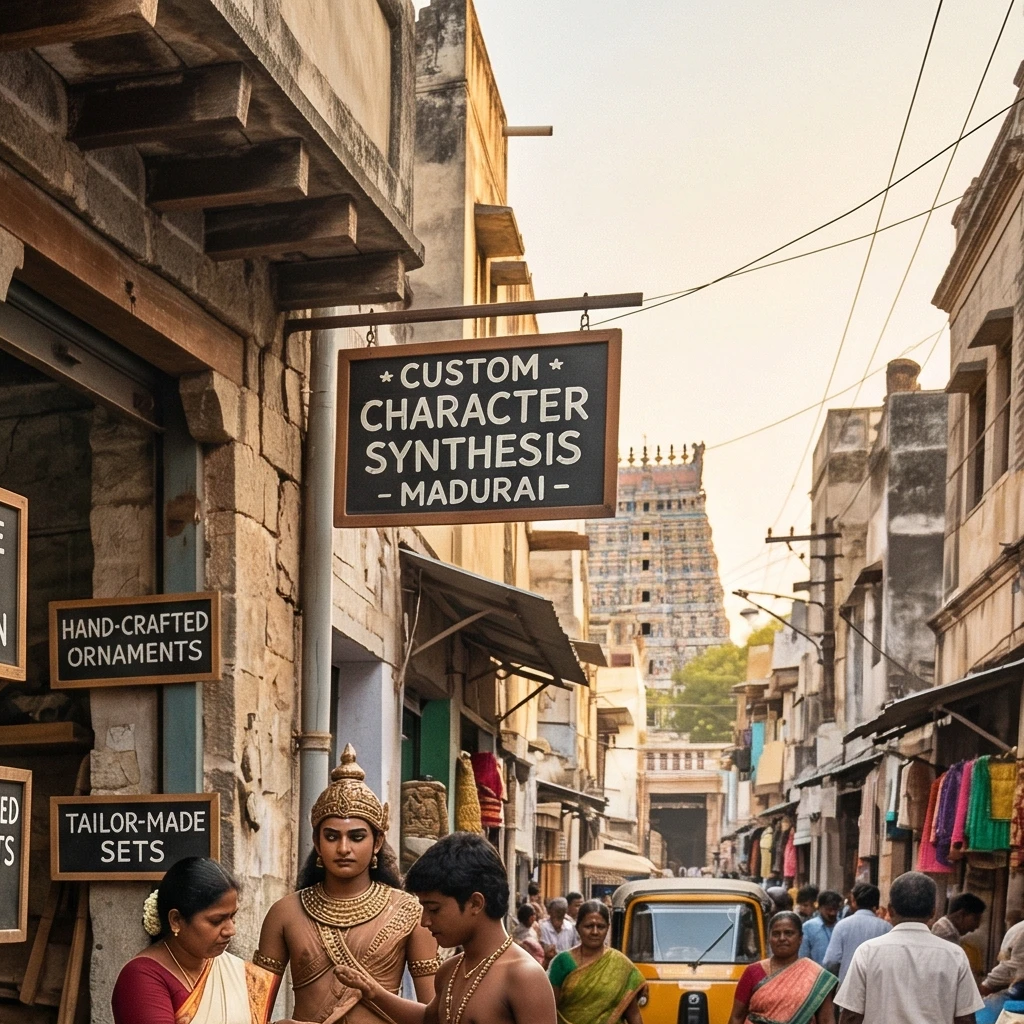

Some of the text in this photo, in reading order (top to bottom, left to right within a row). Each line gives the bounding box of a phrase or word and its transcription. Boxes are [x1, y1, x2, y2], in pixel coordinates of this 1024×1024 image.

[400, 353, 539, 389] CUSTOM
[360, 386, 589, 432] CHARACTER
[364, 429, 582, 475] SYNTHESIS
[400, 475, 545, 507] MADURAI
[61, 610, 209, 640] HAND-CRAFTED
[67, 639, 203, 667] ORNAMENTS
[65, 810, 206, 834] TAILOR-MADE
[100, 839, 165, 863] SETS
